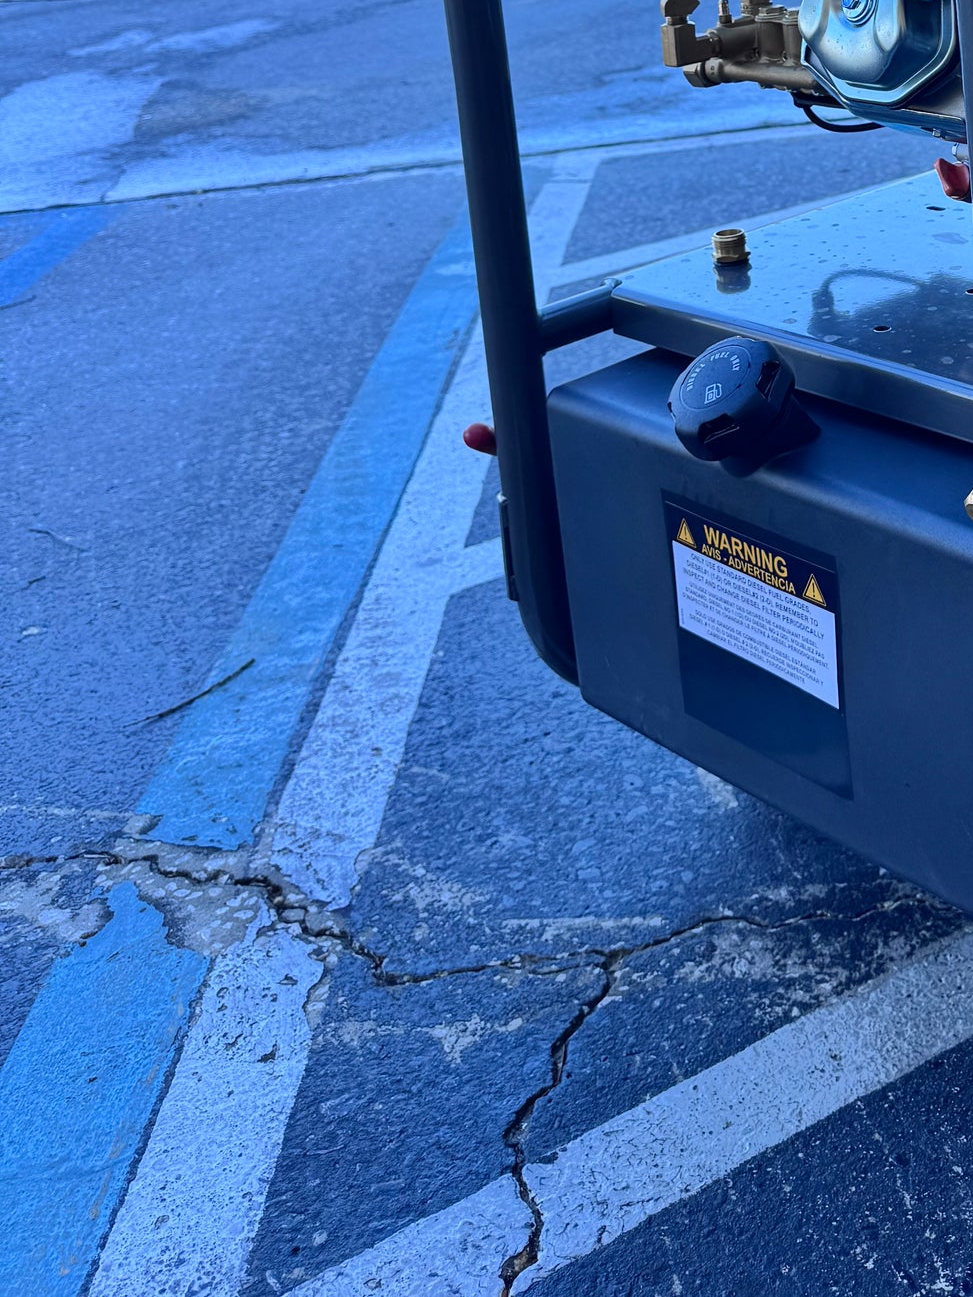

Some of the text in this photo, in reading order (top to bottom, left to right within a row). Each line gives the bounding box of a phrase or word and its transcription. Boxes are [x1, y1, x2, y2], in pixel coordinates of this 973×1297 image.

[710, 351, 730, 361] FUEL
[701, 543, 722, 561] AVIS
[728, 557, 797, 595] ADVERTENCIA
[703, 524, 788, 578] WARNING
